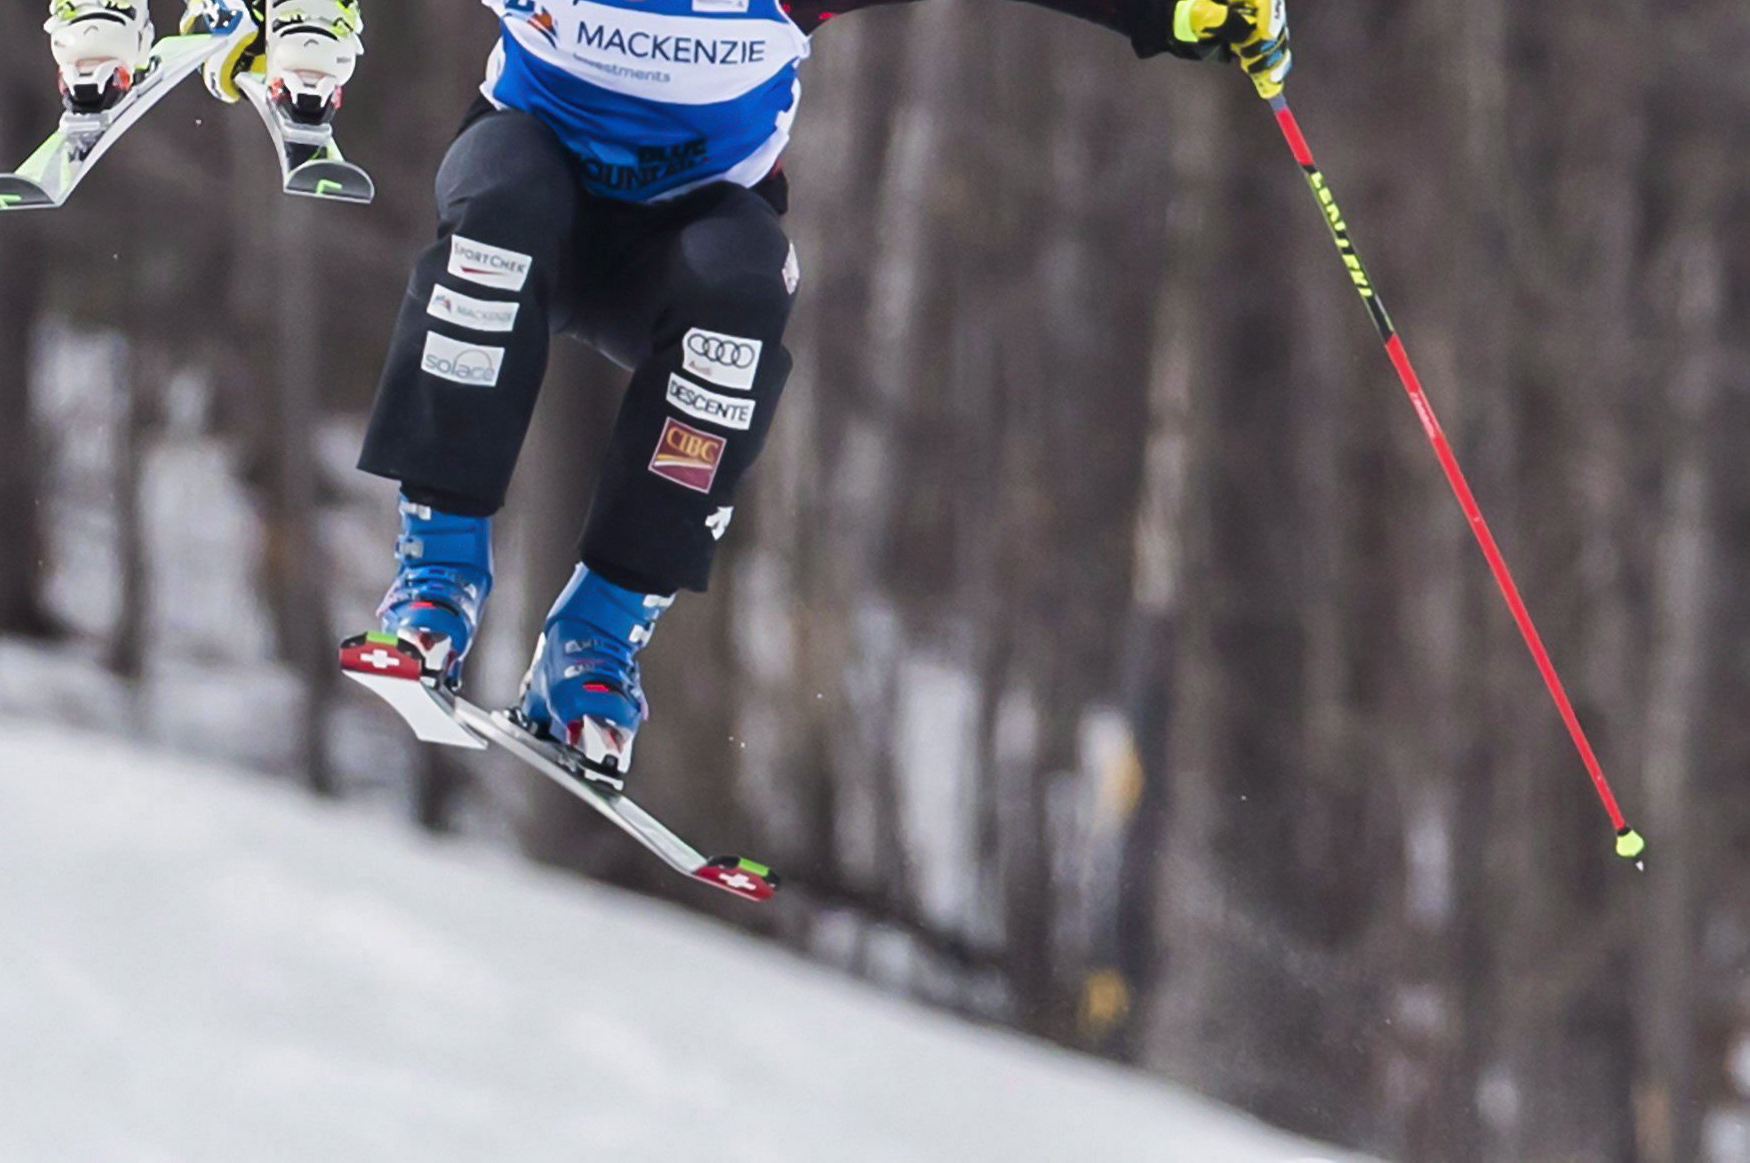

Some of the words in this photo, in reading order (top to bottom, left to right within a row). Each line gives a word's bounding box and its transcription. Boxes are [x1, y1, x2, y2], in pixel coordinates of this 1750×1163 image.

[576, 20, 766, 65] MACKENZIE
[425, 353, 496, 382] solace
[670, 380, 750, 422] DESCENTE
[667, 425, 719, 463] CIBC
